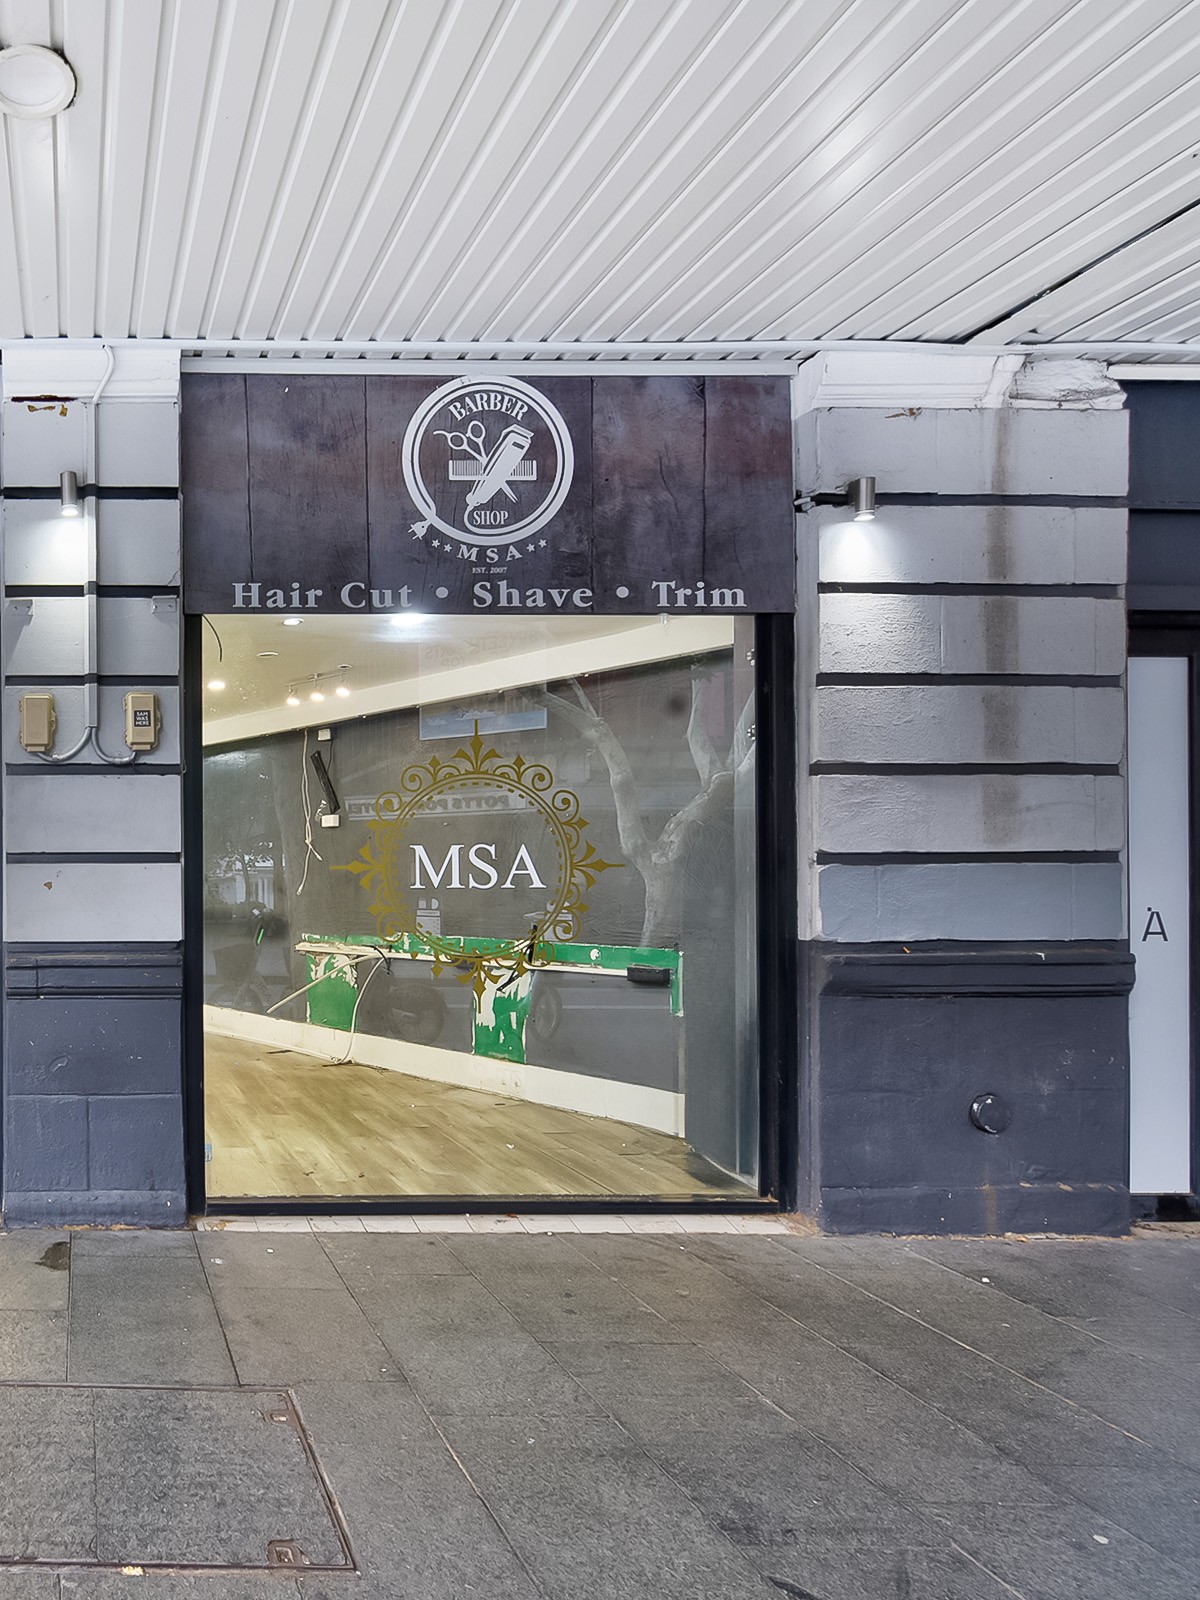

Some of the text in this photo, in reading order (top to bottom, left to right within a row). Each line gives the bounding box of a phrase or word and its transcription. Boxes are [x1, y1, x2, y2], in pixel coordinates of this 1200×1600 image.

[448, 392, 529, 421] BARBER
[473, 510, 509, 525] SHOP
[457, 544, 522, 563] MSA
[472, 566, 508, 574] EST. 2007
[232, 581, 747, 609] Hair Cut Shave Trim
[409, 843, 547, 890] MSA
